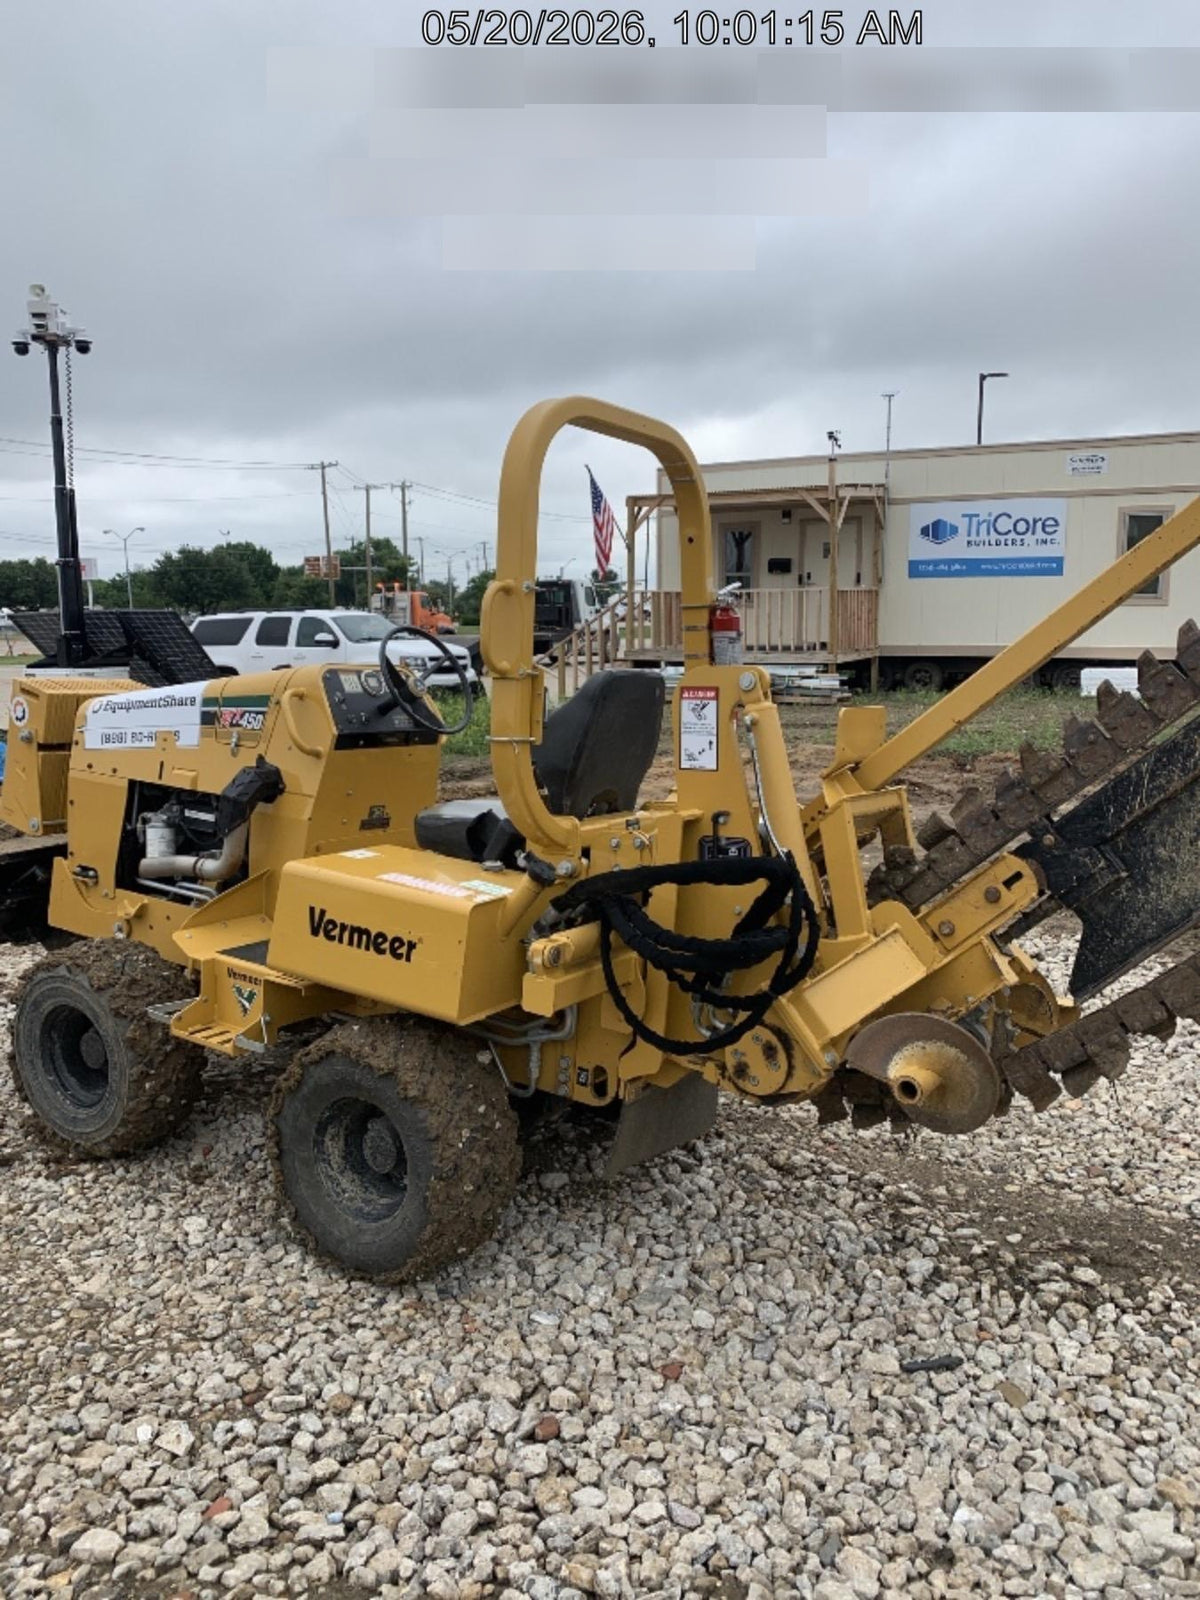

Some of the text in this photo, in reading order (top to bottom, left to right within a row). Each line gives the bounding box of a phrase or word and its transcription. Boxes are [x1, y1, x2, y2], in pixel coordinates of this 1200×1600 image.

[961, 512, 1060, 538] TriCore
[966, 537, 1061, 548] BUILDERS, INC.
[103, 694, 197, 714] EquipmentShare
[308, 905, 417, 963] Vermeer
